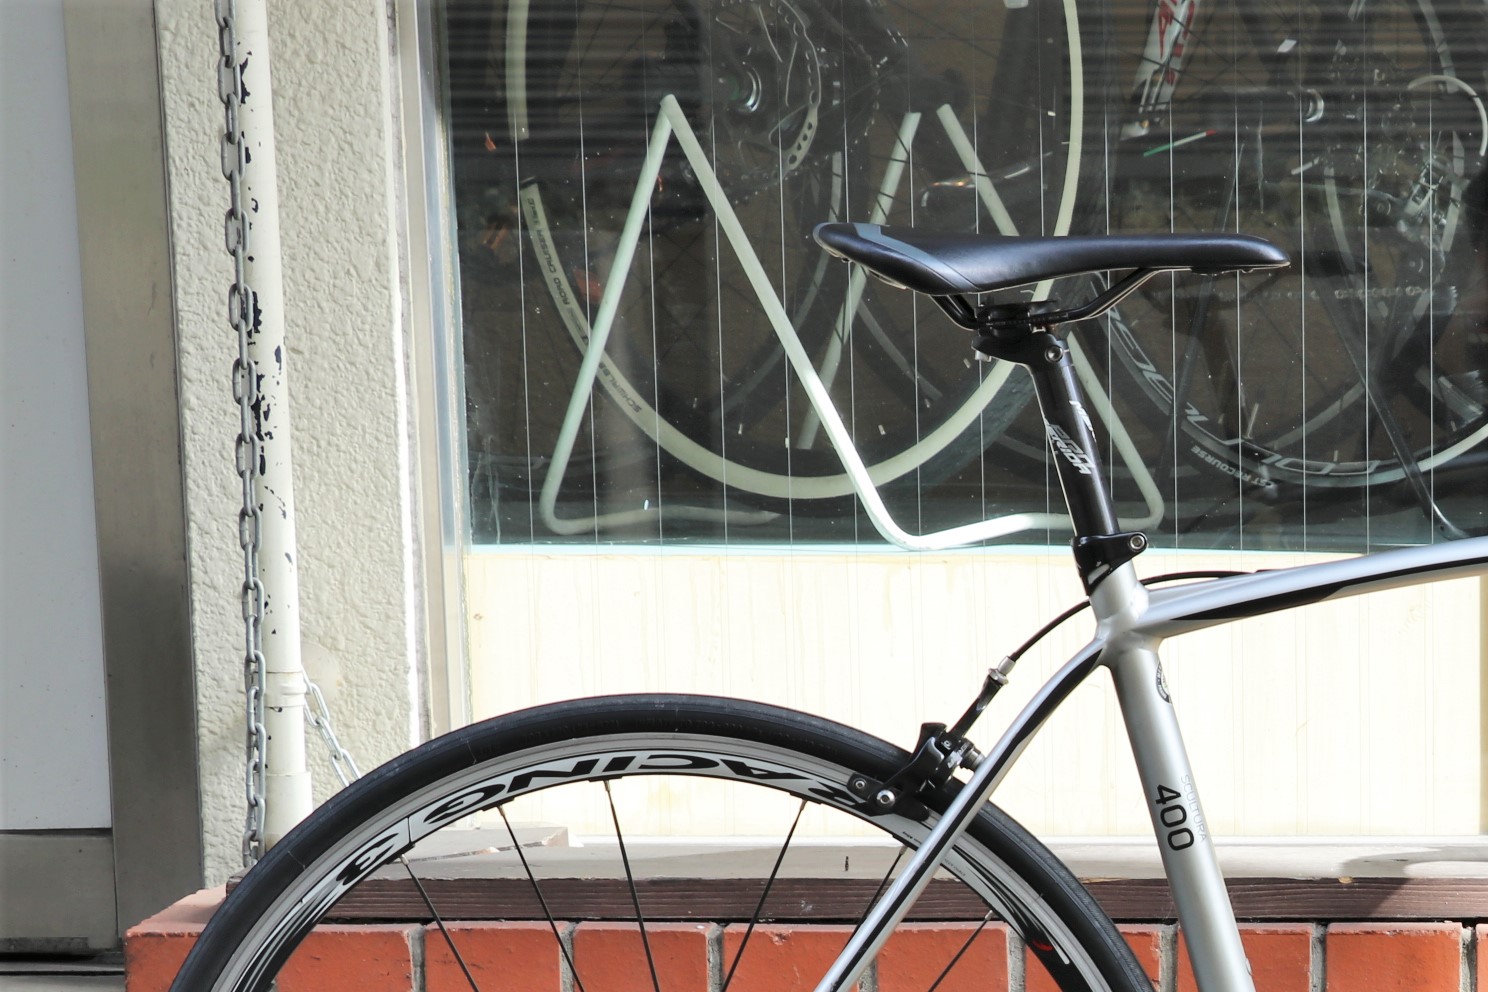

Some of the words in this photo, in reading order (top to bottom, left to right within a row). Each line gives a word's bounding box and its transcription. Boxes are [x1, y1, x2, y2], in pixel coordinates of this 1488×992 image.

[1189, 443, 1256, 483] RECOURSE
[1155, 783, 1196, 852] 400
[1180, 773, 1208, 843] SCULTURA
